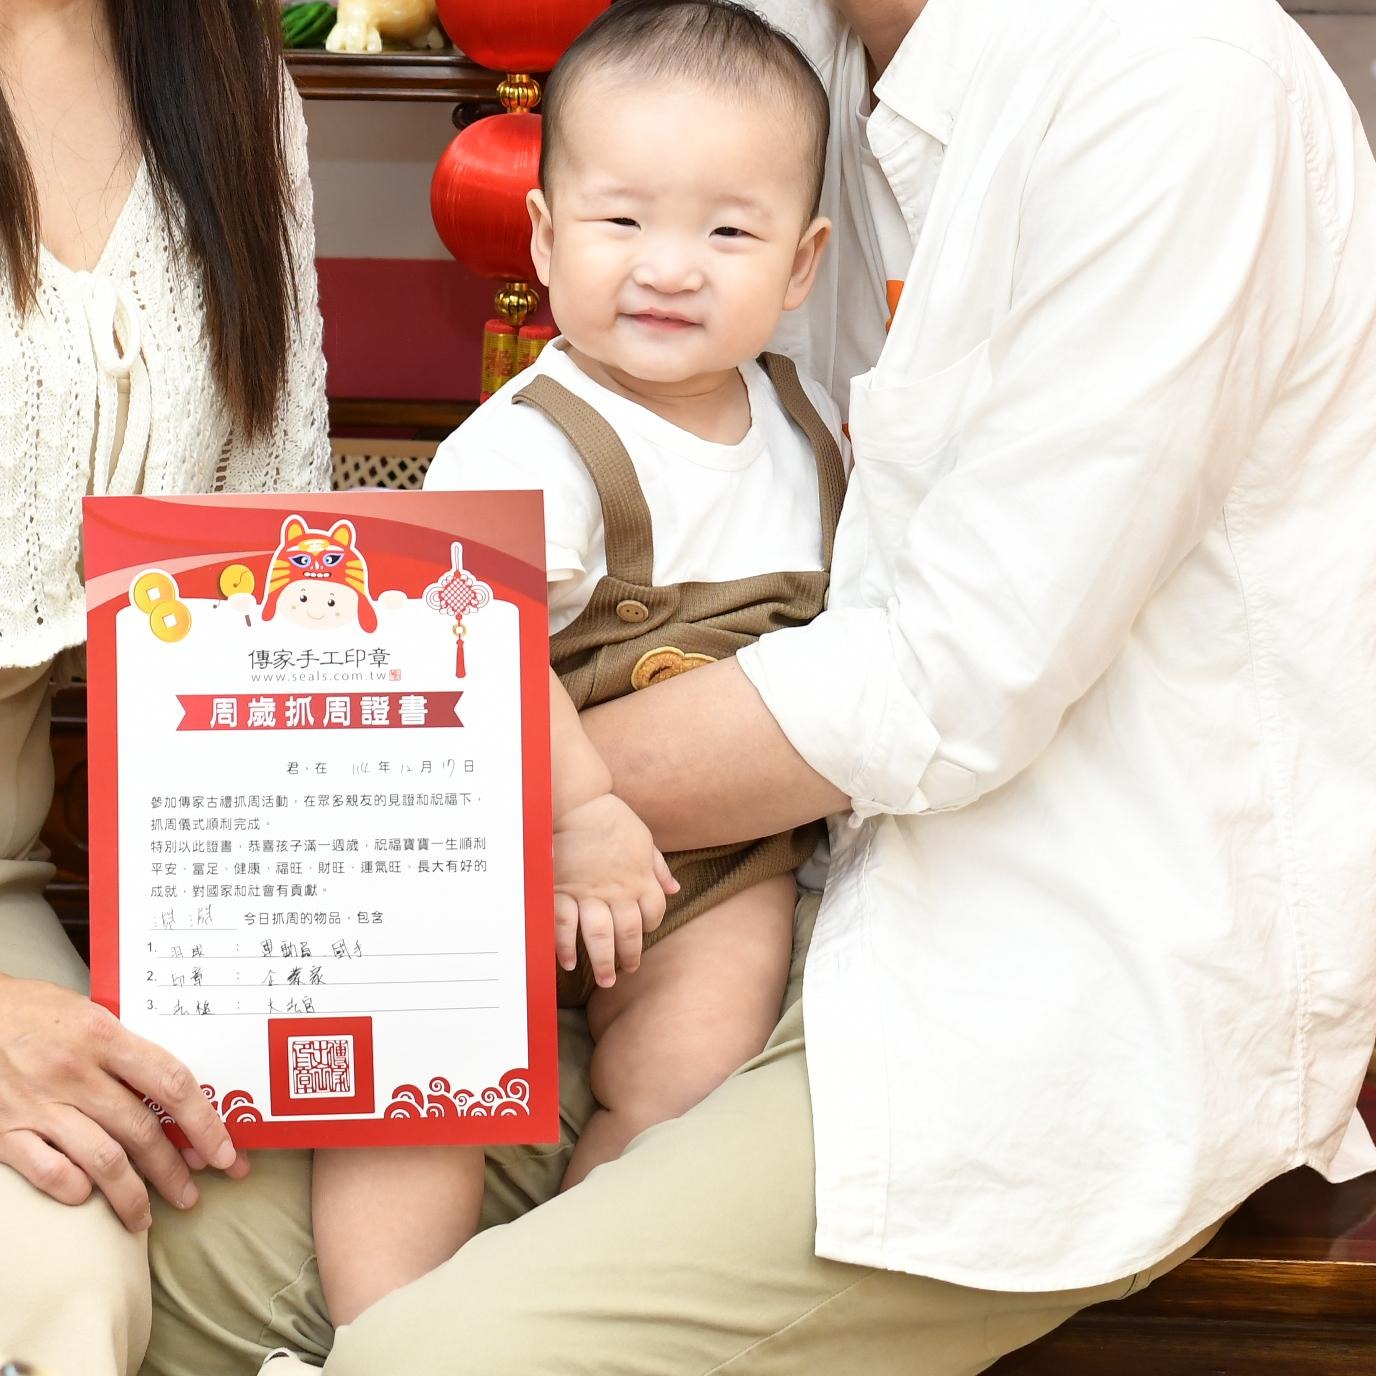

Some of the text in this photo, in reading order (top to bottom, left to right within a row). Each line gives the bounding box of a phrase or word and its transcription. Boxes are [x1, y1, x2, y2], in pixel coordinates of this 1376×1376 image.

[247, 647, 391, 670] 傳家手工印章
[250, 670, 387, 683] www.seals.com.tw
[209, 694, 430, 729] 周歲抓周證書
